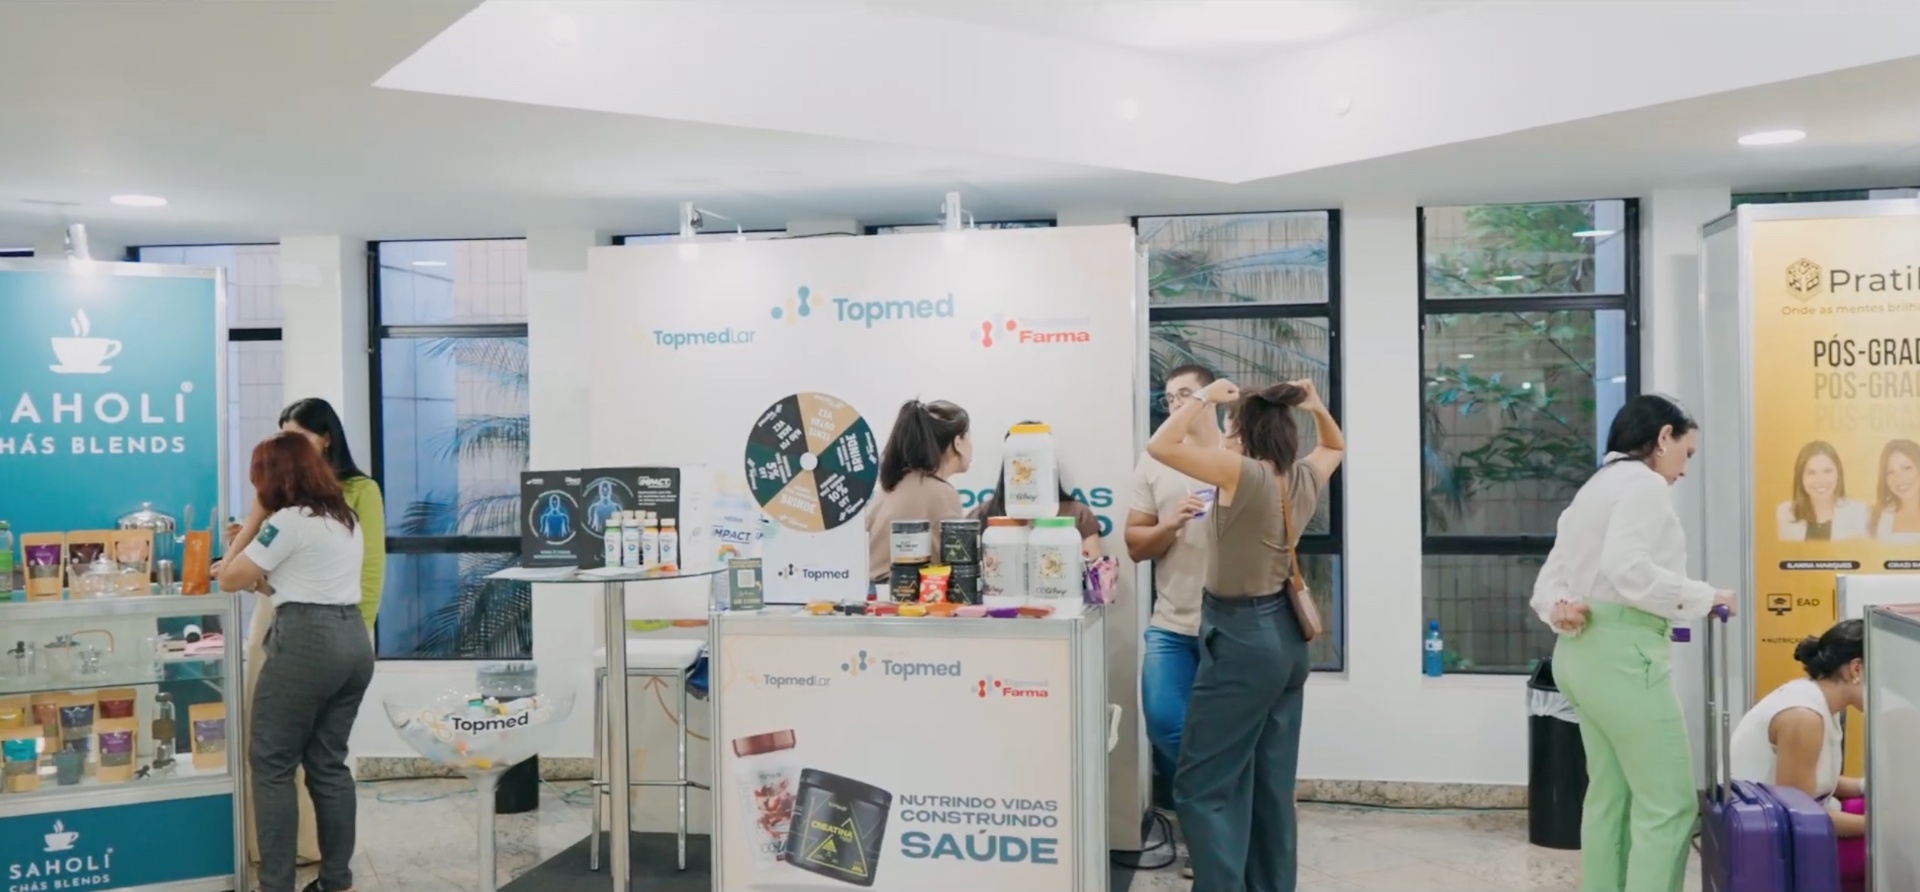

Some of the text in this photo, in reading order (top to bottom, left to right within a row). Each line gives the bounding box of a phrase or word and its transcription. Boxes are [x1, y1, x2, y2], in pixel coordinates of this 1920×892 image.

[832, 293, 955, 328] Topmed
[1782, 305, 1816, 315] Onde
[1819, 306, 1833, 314] as
[1836, 304, 1885, 313] mentes
[653, 328, 755, 350] TopmedLar
[1019, 330, 1090, 344] Farma
[8, 392, 186, 424] AHOLI
[0, 433, 186, 455] HÁS BLENDS
[845, 433, 864, 472] BRINDE
[766, 461, 780, 480] 5%
[828, 483, 848, 502] 10%
[781, 493, 816, 514] BRINDE
[802, 568, 849, 581] Topmed
[1797, 598, 1820, 607] EAD
[882, 660, 961, 681] Topmed
[763, 674, 831, 689] TopmedLar
[1002, 687, 1048, 698] Farma
[452, 712, 529, 735] Topmed
[900, 794, 1058, 812] NUTRINDO VIDAS
[811, 820, 853, 838] CREATINA
[900, 810, 1059, 829] CONSTRUINDO
[900, 829, 1059, 865] SAÚDE
[9, 874, 111, 892] CHÁS BLENDS
